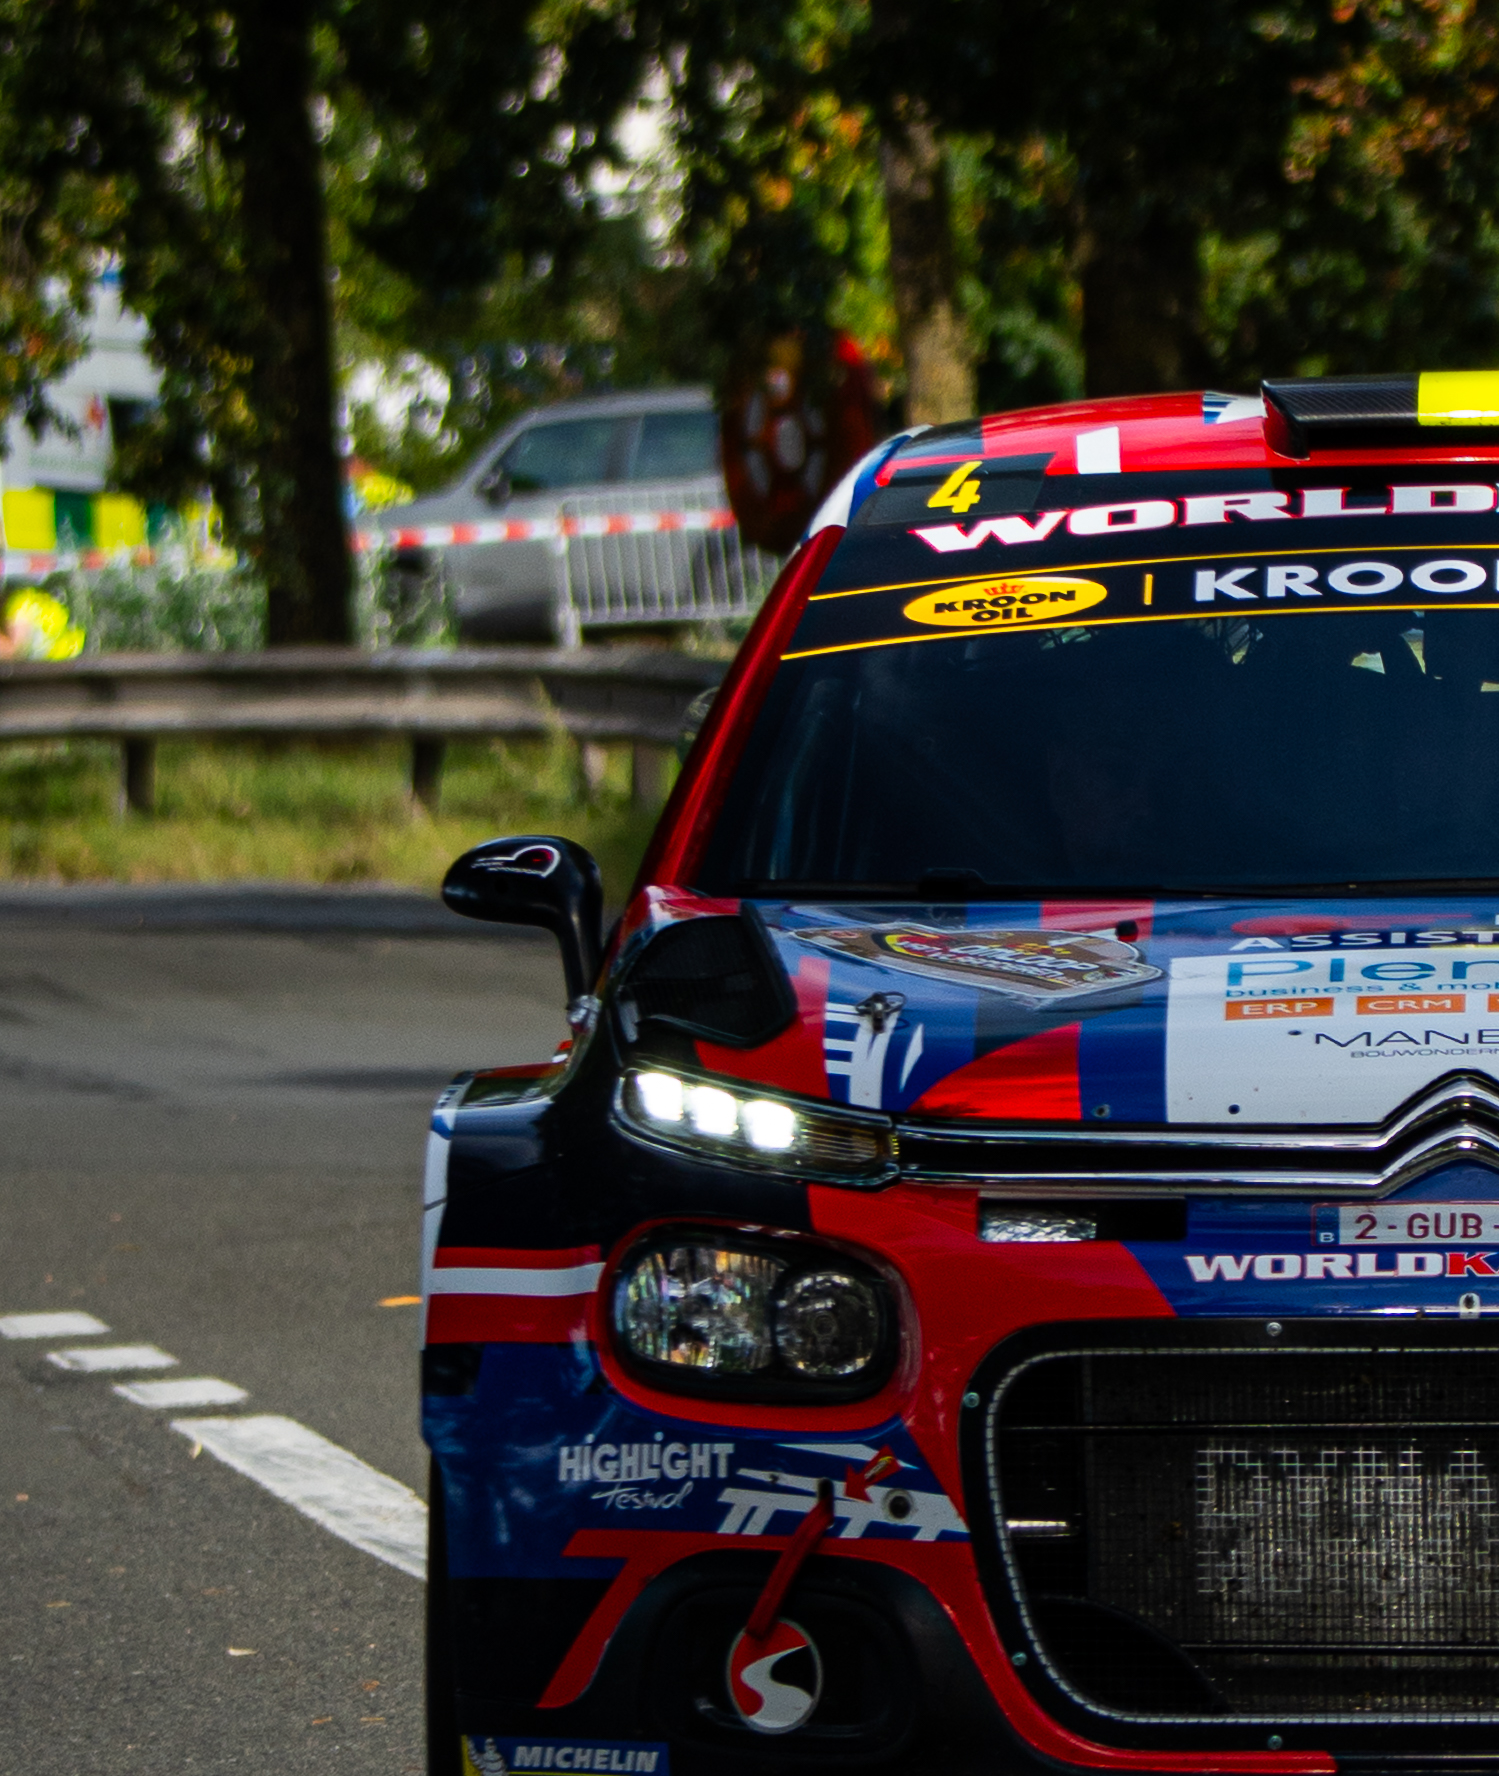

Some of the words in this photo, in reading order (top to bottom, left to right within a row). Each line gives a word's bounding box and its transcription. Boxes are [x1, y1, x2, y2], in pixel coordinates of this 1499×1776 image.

[926, 461, 982, 514] 4
[932, 587, 1077, 614] KROON
[970, 603, 1035, 622] OIL
[1226, 984, 1384, 997] business
[1397, 982, 1421, 992] &
[1242, 1002, 1318, 1016] ERP
[1368, 999, 1452, 1011] CRM
[1319, 1232, 1335, 1243] B
[514, 1745, 660, 1773] MICHELIN
